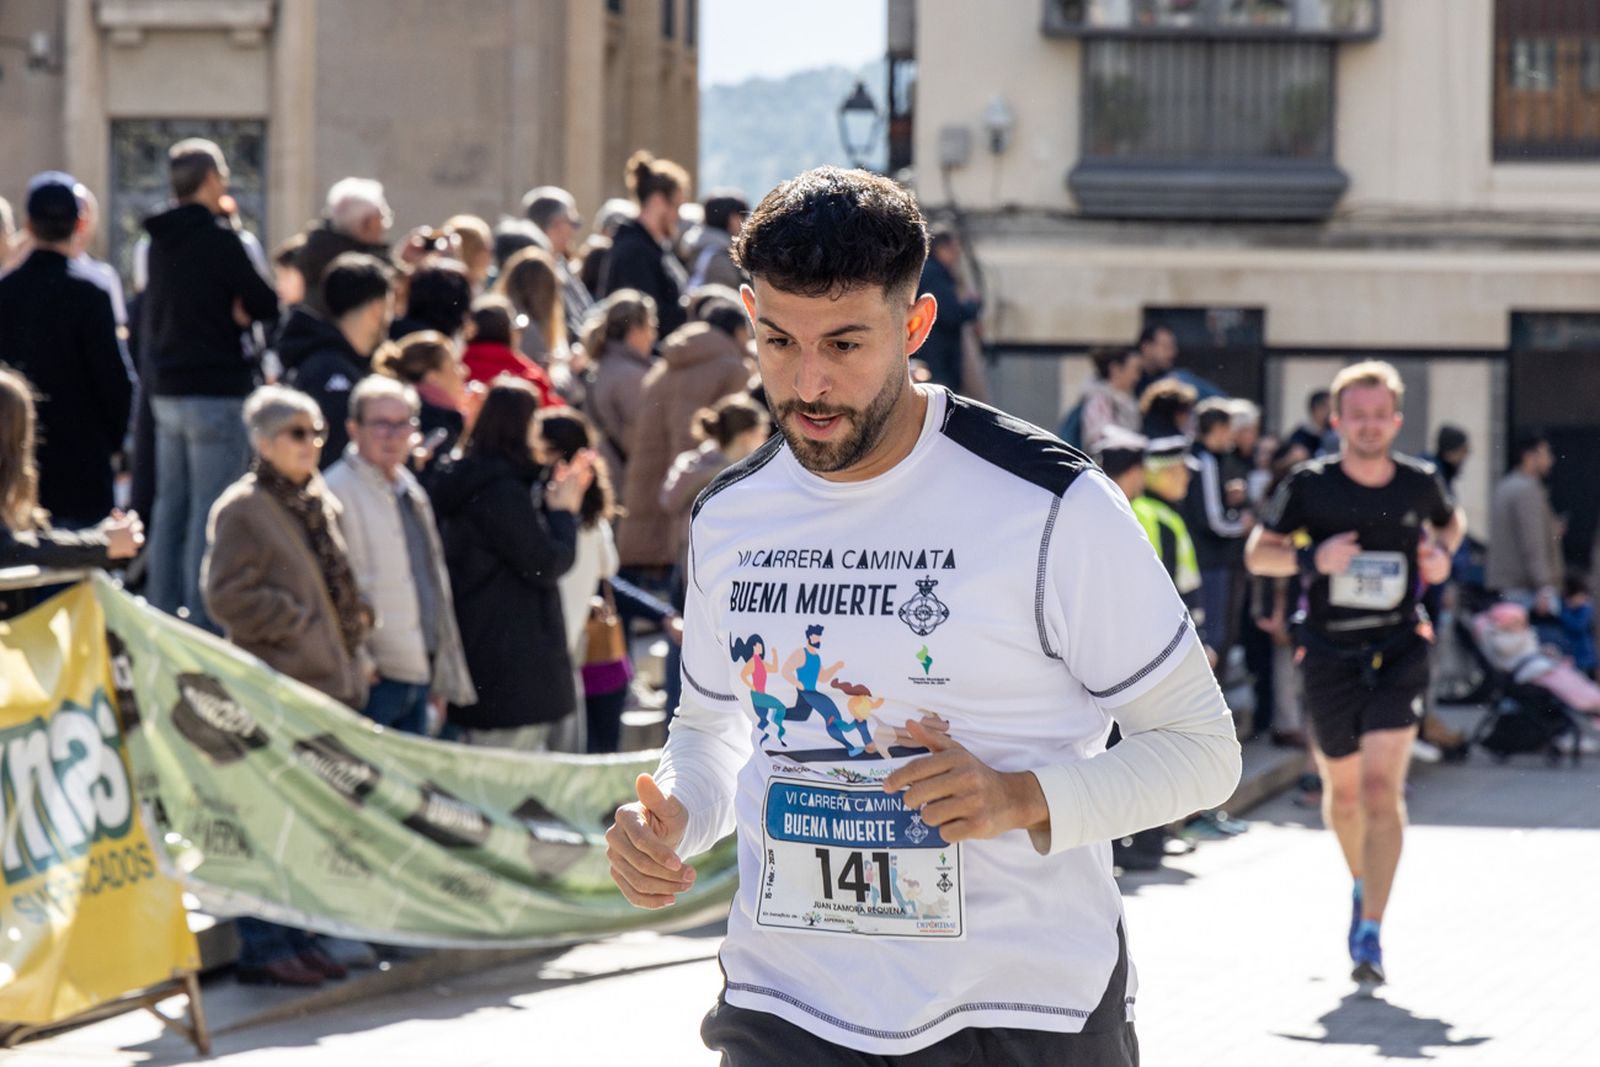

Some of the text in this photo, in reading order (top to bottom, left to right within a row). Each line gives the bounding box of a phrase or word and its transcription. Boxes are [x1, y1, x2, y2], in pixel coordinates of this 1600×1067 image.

[752, 548, 834, 569] CARRERA
[841, 548, 956, 570] CAMINATA
[729, 580, 897, 616] BUENA MUERTE
[785, 791, 797, 805] VI
[799, 792, 852, 812] CARRERA
[783, 812, 896, 842] BUENA MUERTE
[815, 847, 892, 904] 141
[813, 901, 907, 916] JUAN ZAMORA REQUENA
